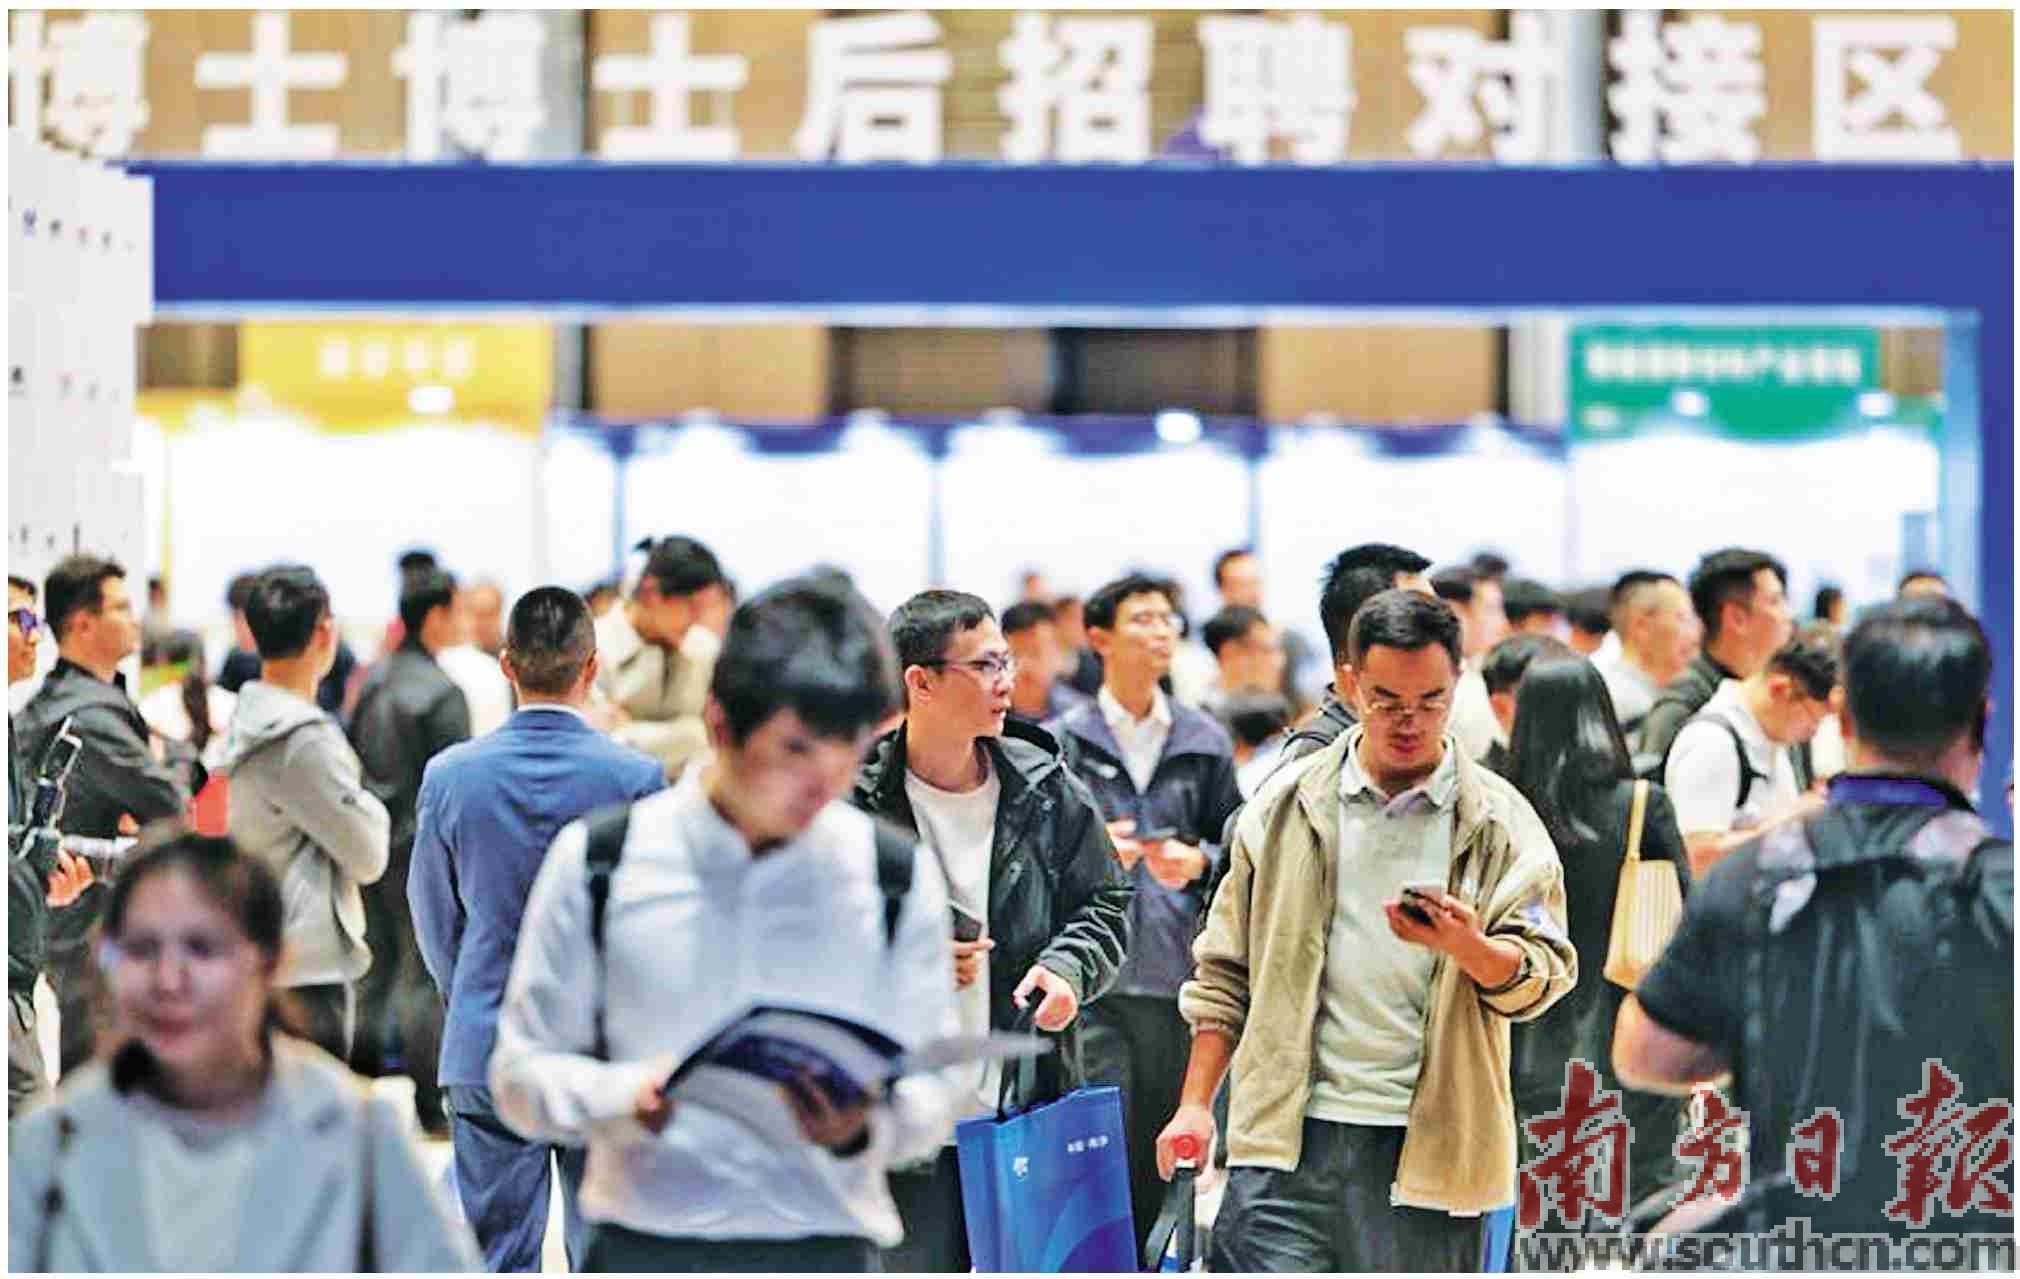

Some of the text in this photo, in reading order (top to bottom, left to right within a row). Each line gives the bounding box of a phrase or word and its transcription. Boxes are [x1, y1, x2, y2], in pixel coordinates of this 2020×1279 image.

[9, 13, 1959, 163] 博士博士后招聘对接区
